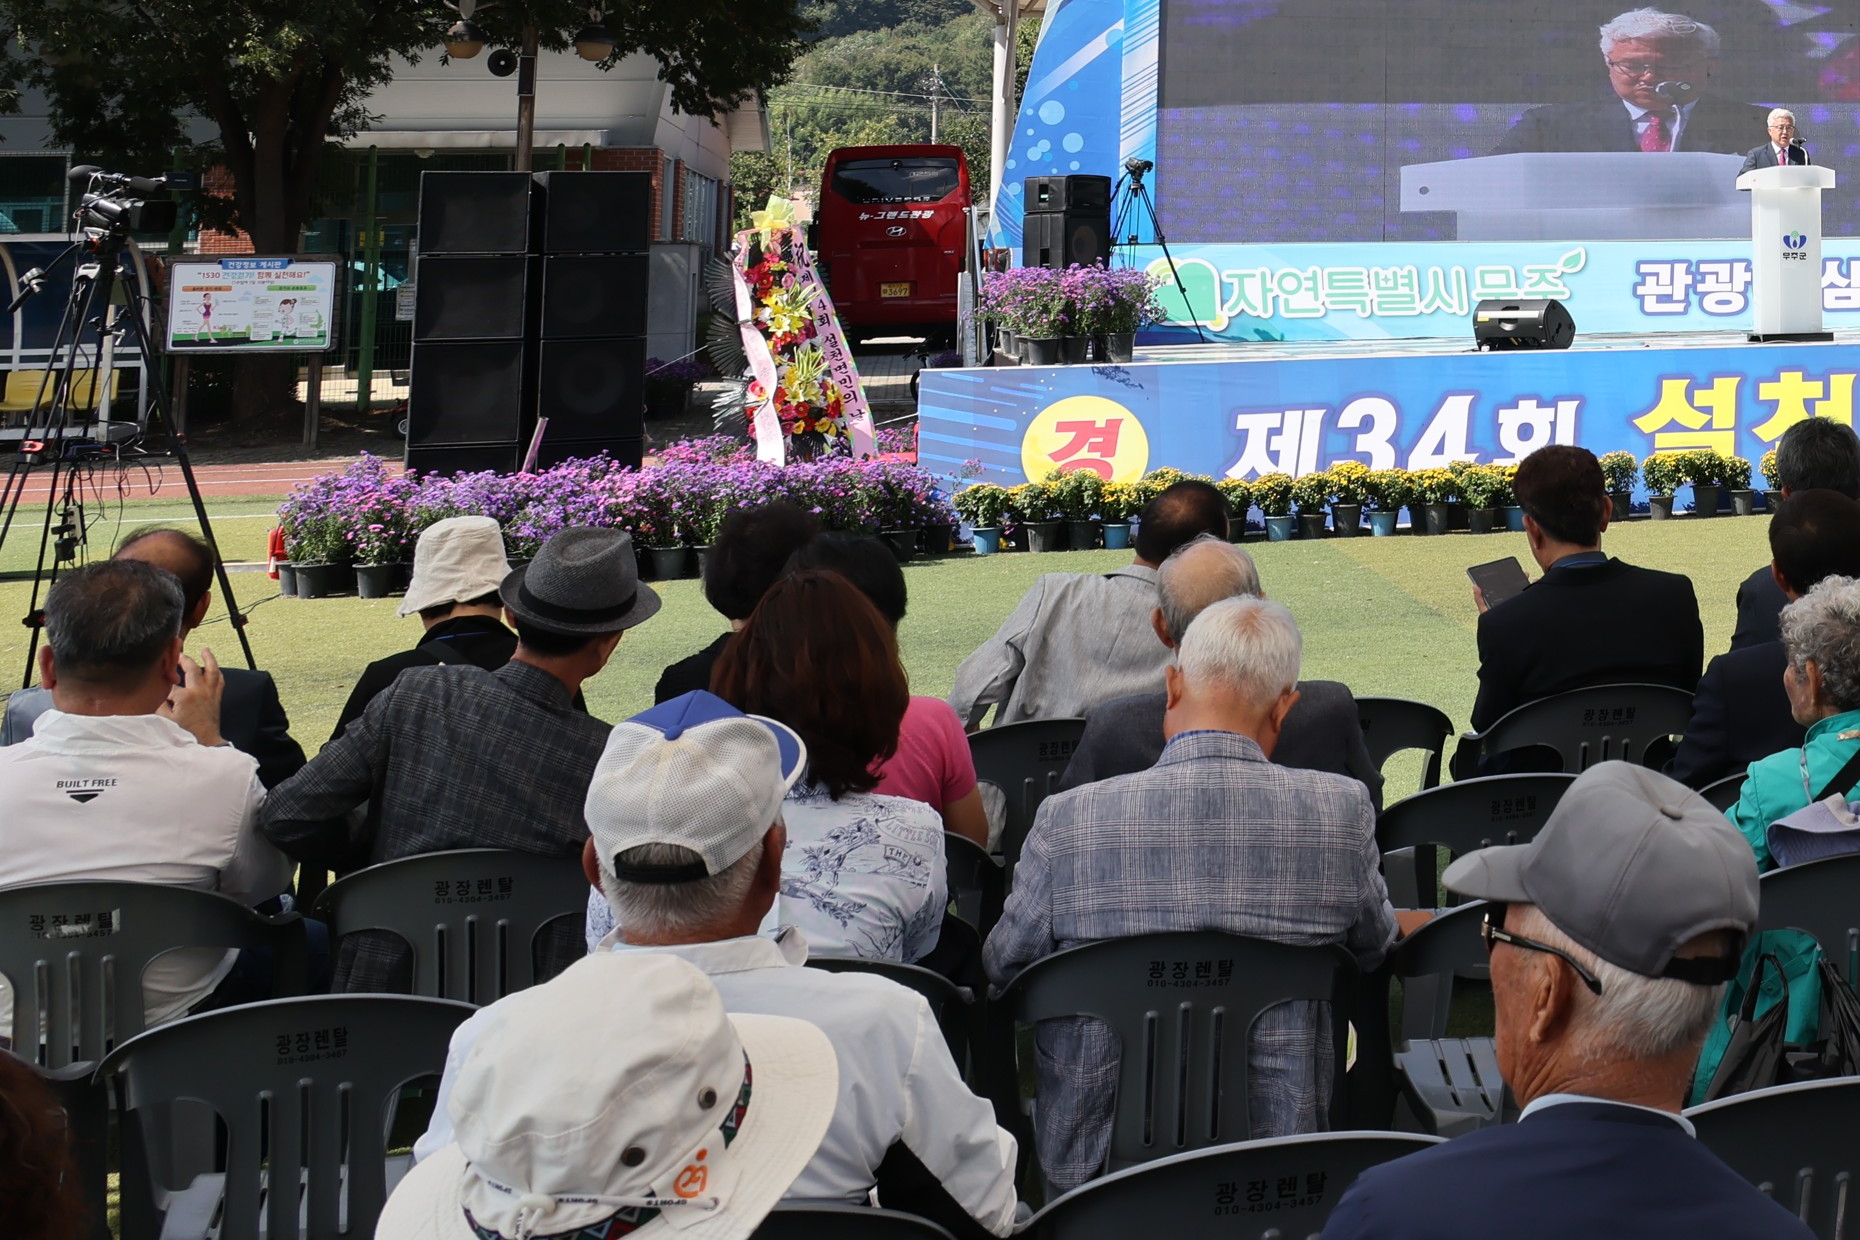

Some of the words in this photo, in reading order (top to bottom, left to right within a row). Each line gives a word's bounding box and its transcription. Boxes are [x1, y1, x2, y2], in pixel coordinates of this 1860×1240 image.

[1782, 252, 1807, 260] 무주군
[801, 270, 831, 328] 제4회
[1047, 418, 1125, 471] 경
[1583, 707, 1636, 721] 광장렌탈
[56, 779, 89, 788] BUILT
[92, 778, 118, 787] FREE
[889, 847, 909, 862] THE
[435, 877, 514, 896] 광장렌탈
[434, 893, 511, 904] 010-4304-3457
[1149, 959, 1235, 979] 광장렌탈
[1147, 977, 1231, 988] 010-4304-3457
[276, 1026, 348, 1055] 광장렌탈
[1215, 1170, 1328, 1205] 광장렌탈
[645, 1198, 688, 1207] SPORTS
[1214, 1194, 1323, 1216] 010-4304-3457
